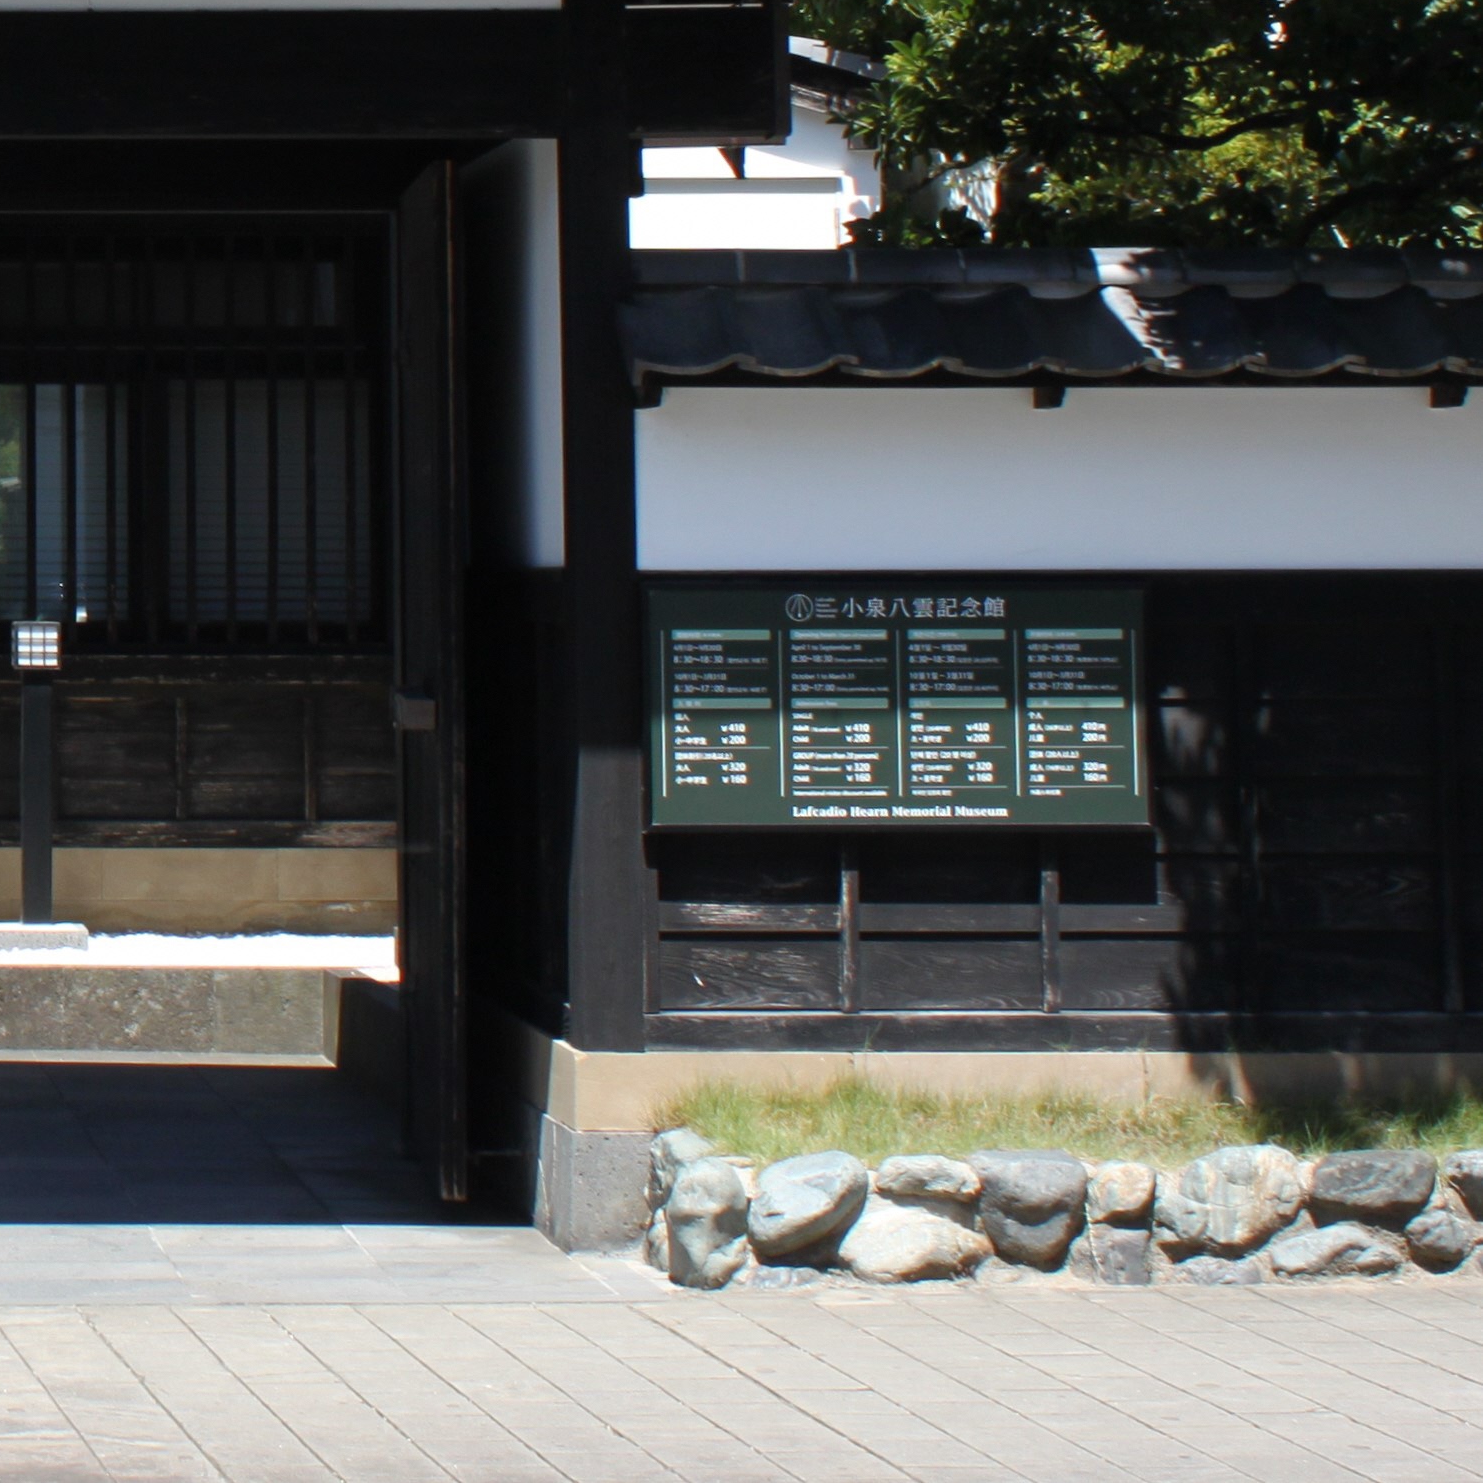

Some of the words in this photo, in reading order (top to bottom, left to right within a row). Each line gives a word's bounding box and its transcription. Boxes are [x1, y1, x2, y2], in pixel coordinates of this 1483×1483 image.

[841, 597, 1005, 618] 小泉八雲記念館
[792, 806, 849, 818] Lafcadio
[850, 806, 890, 818] Hearn
[892, 806, 952, 818] Memorial
[953, 806, 1010, 818] Museum
